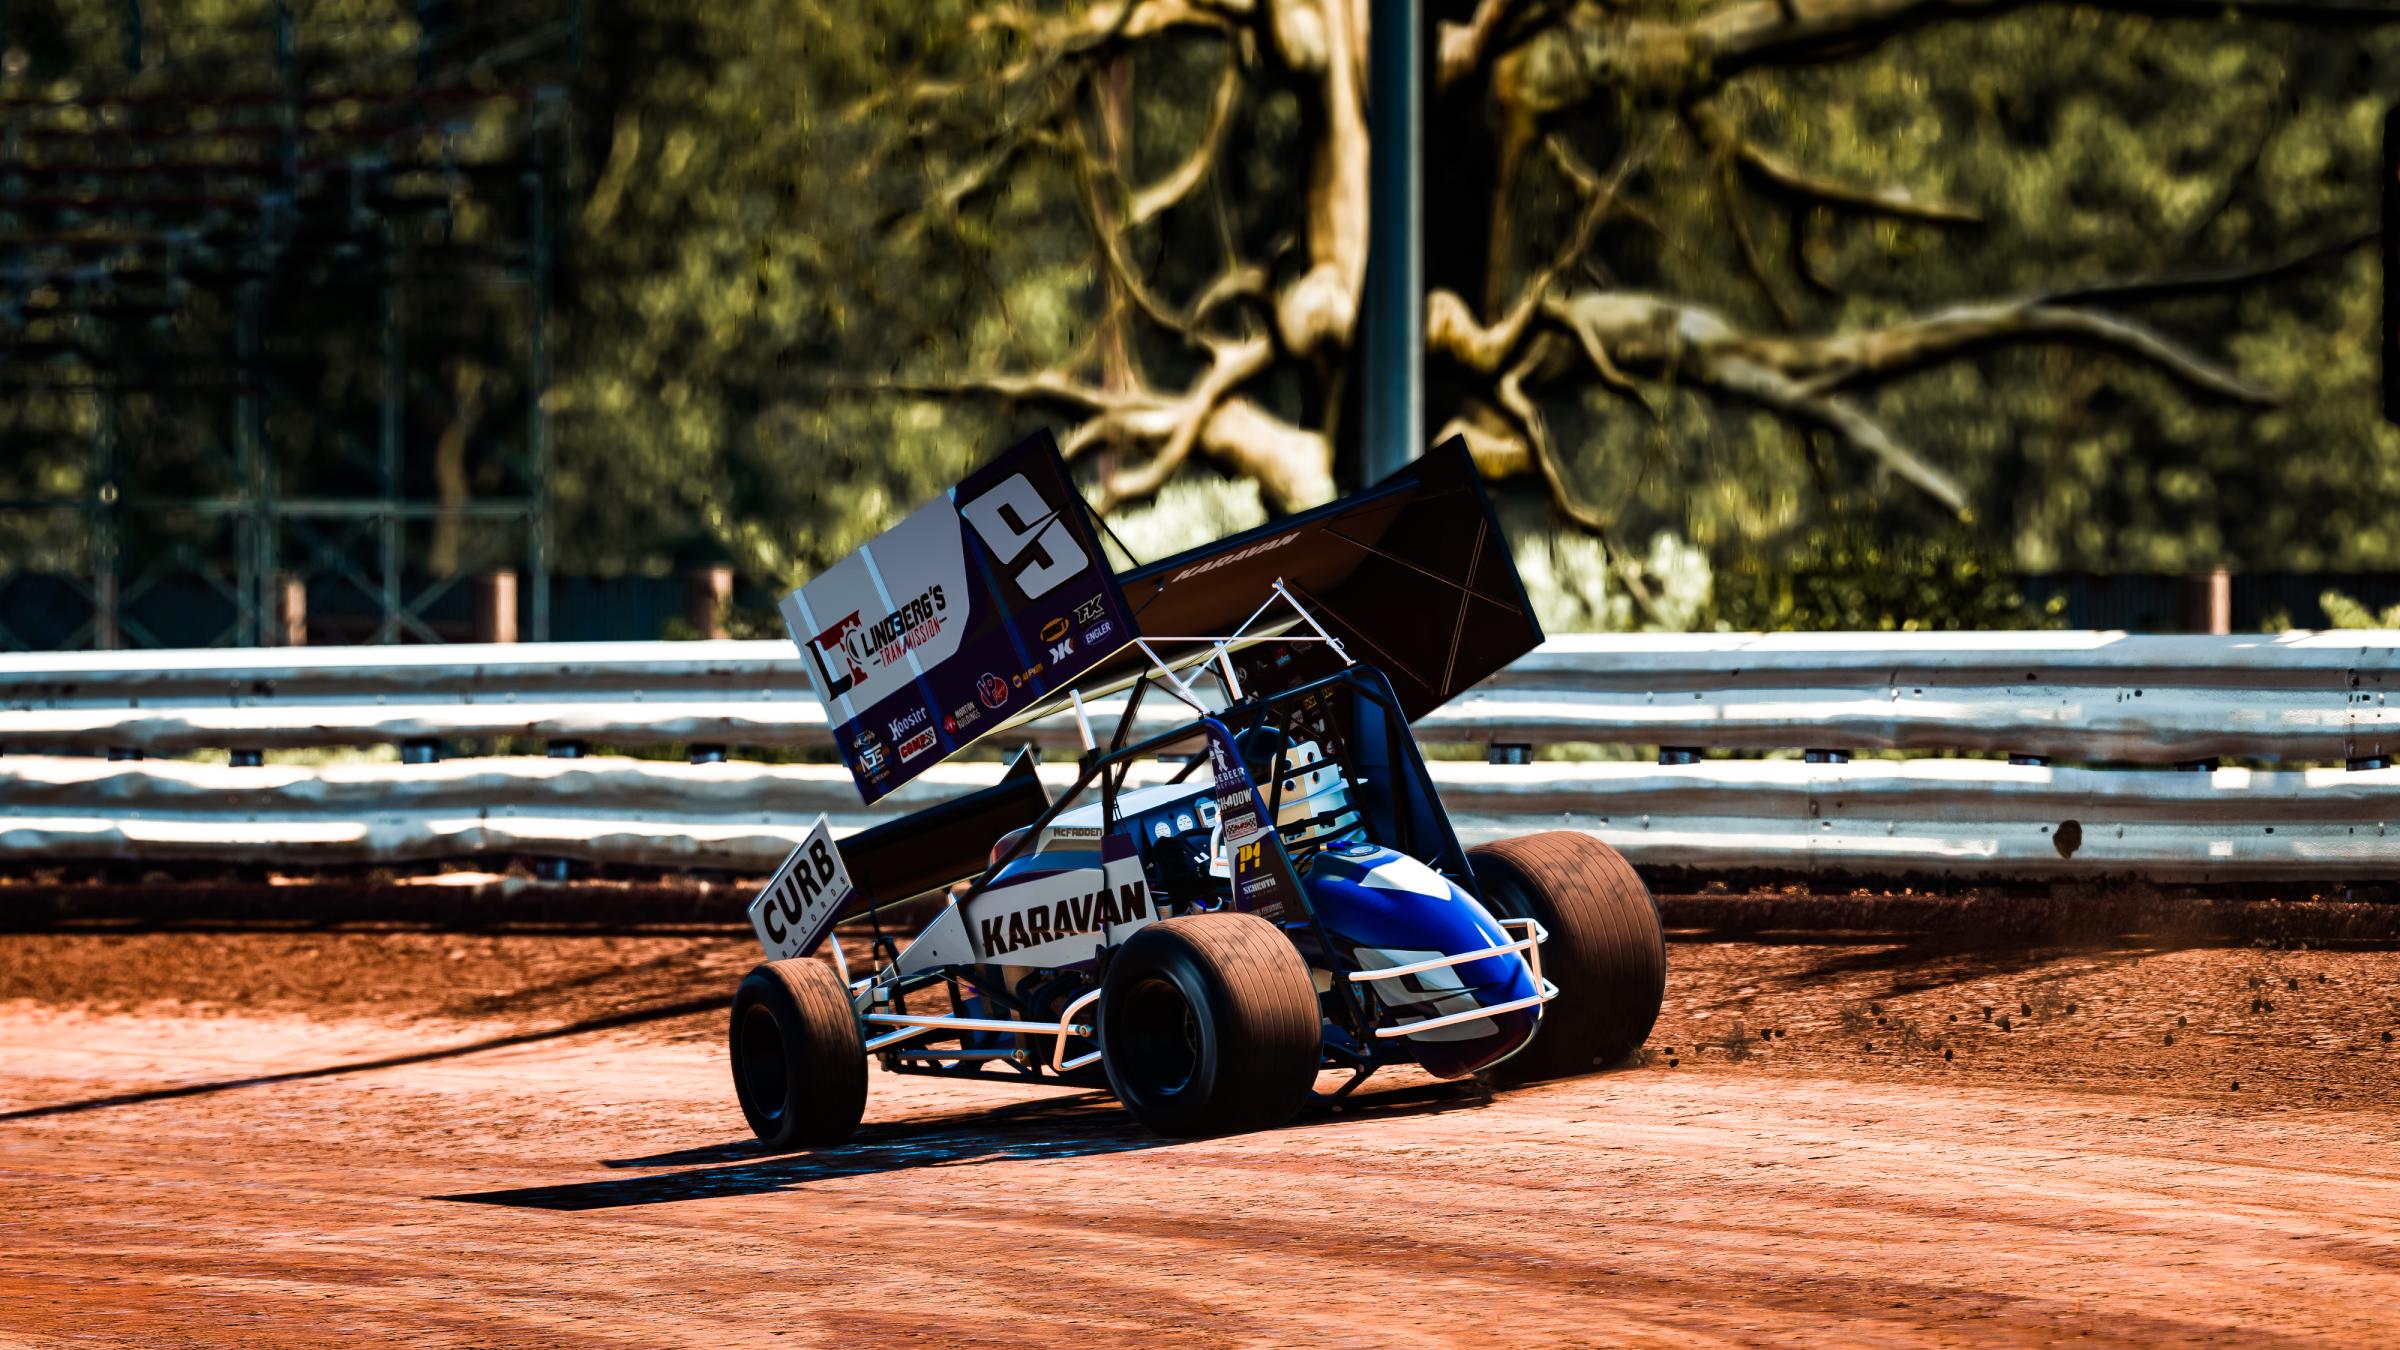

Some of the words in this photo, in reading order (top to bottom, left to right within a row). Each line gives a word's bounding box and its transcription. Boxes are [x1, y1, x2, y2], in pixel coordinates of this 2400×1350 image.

[961, 472, 1089, 600] 9
[1085, 622, 1112, 644] ENGLER
[888, 707, 927, 741] Hoosier
[764, 838, 835, 945] CURB
[782, 877, 846, 960] RECORDS
[981, 880, 1147, 958] KARAVAN
